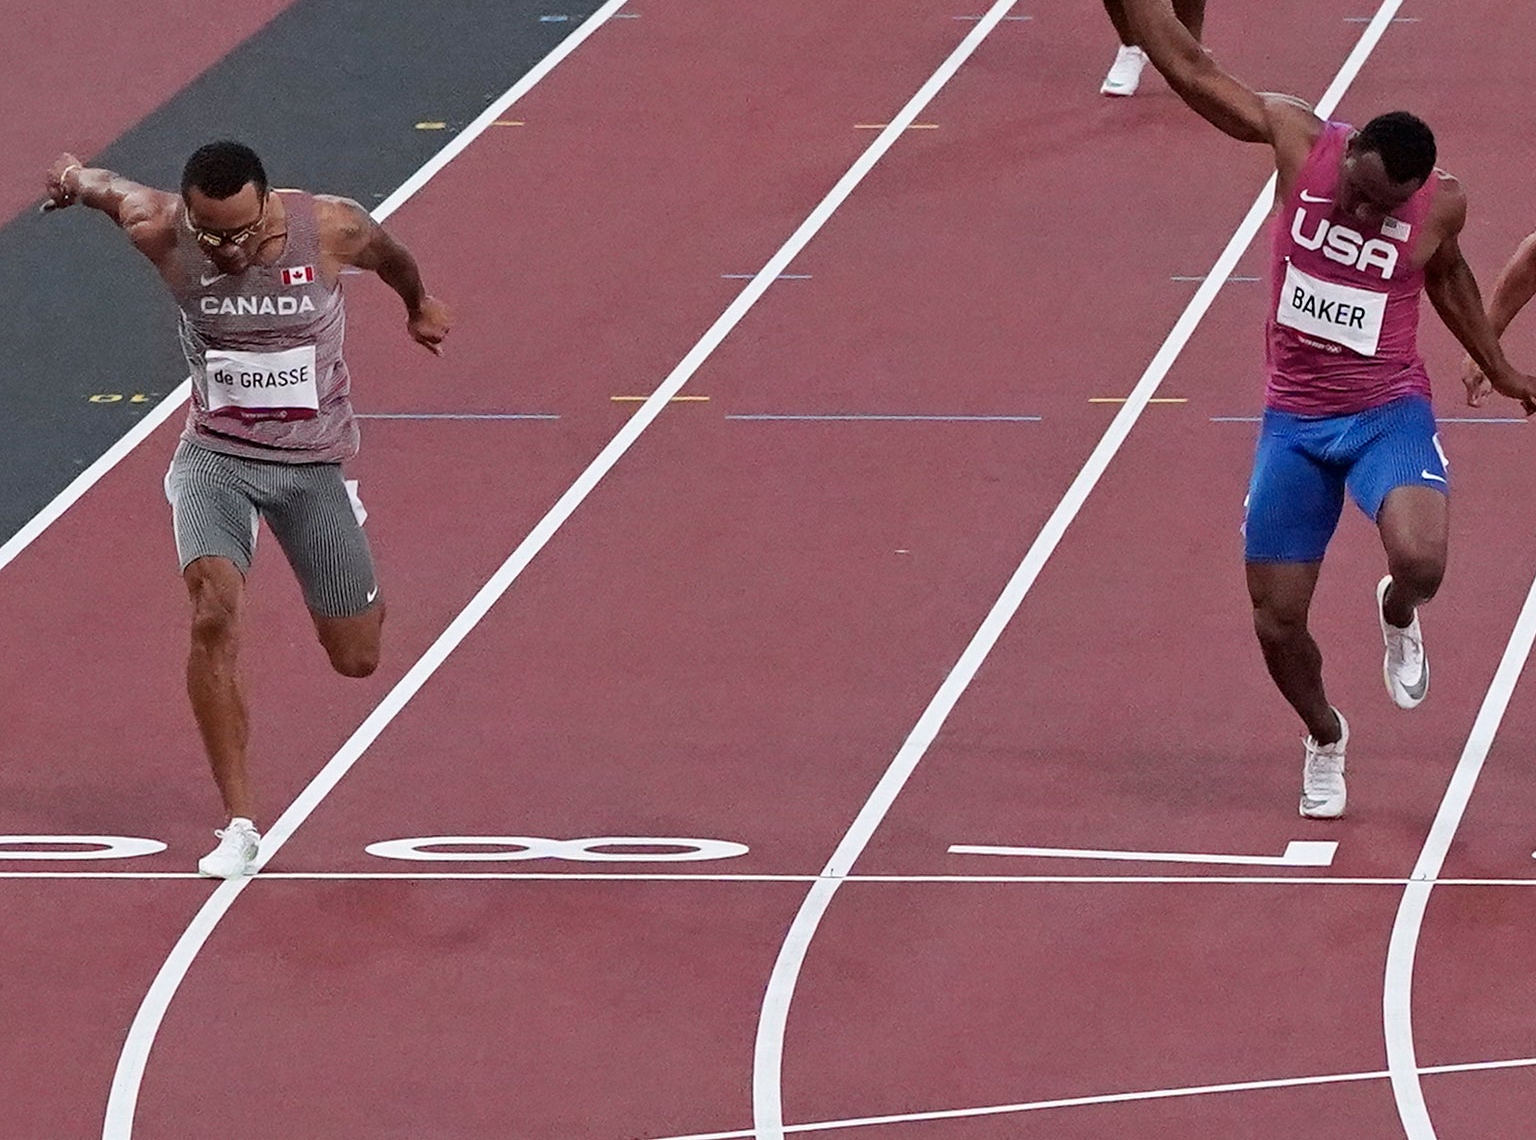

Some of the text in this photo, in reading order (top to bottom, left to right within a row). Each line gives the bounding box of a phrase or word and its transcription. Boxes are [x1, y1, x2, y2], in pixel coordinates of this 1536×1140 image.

[1291, 206, 1399, 280] USA
[200, 295, 315, 315] CANADA
[1292, 286, 1366, 329] BAKER
[214, 365, 309, 388] de GRASSE
[365, 836, 750, 862] 8
